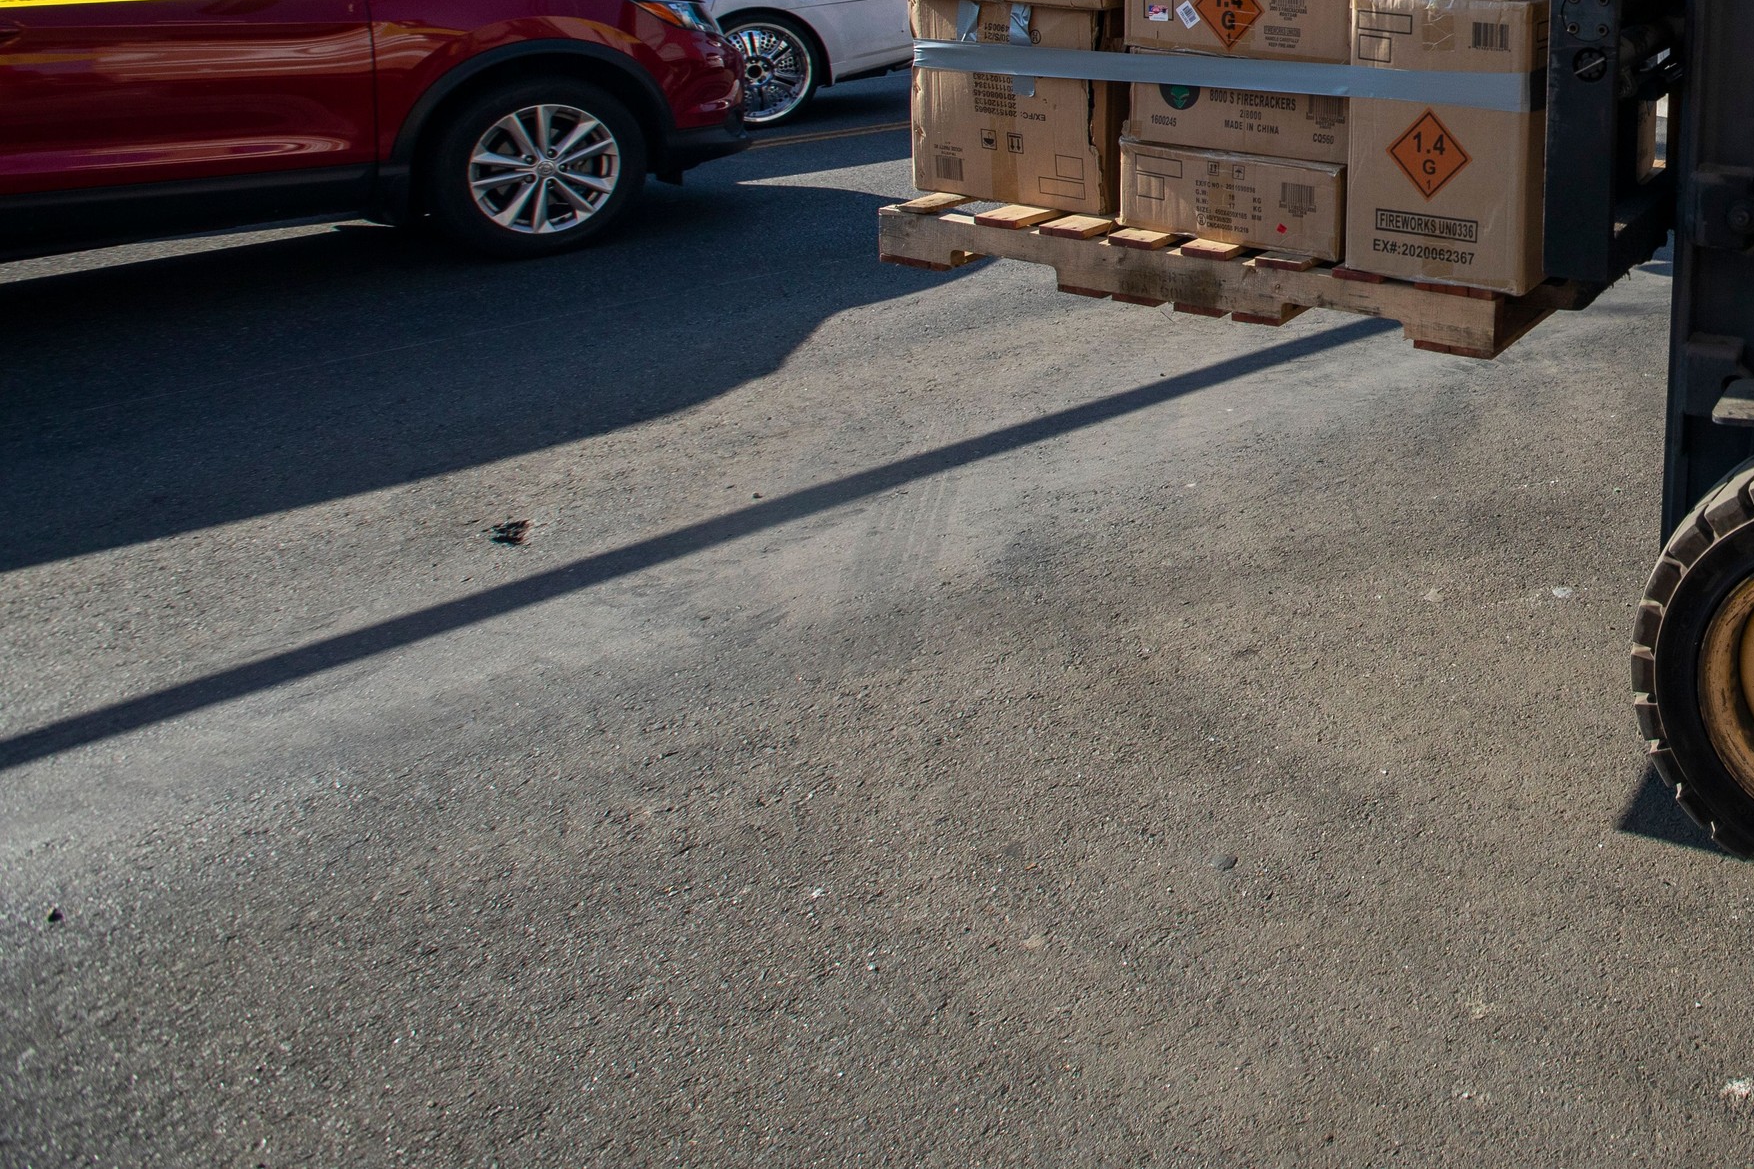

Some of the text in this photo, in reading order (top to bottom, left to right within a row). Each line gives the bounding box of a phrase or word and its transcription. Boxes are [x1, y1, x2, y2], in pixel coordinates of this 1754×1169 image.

[1222, 11, 1235, 30] G
[1209, 89, 1296, 111] 8000 S FIRECRACKERS
[1021, 111, 1046, 121] EX/FC:
[1151, 114, 1177, 127] 1600245
[1239, 109, 1261, 120] 2/8000
[1224, 119, 1279, 135] MADE IN CHINA
[1312, 133, 1334, 145] CQ560
[1412, 131, 1445, 155] 1.4
[1422, 159, 1436, 175] G
[1379, 212, 1474, 239] FIREWORKS UN0336
[1373, 238, 1475, 265] EX#:2020062367
